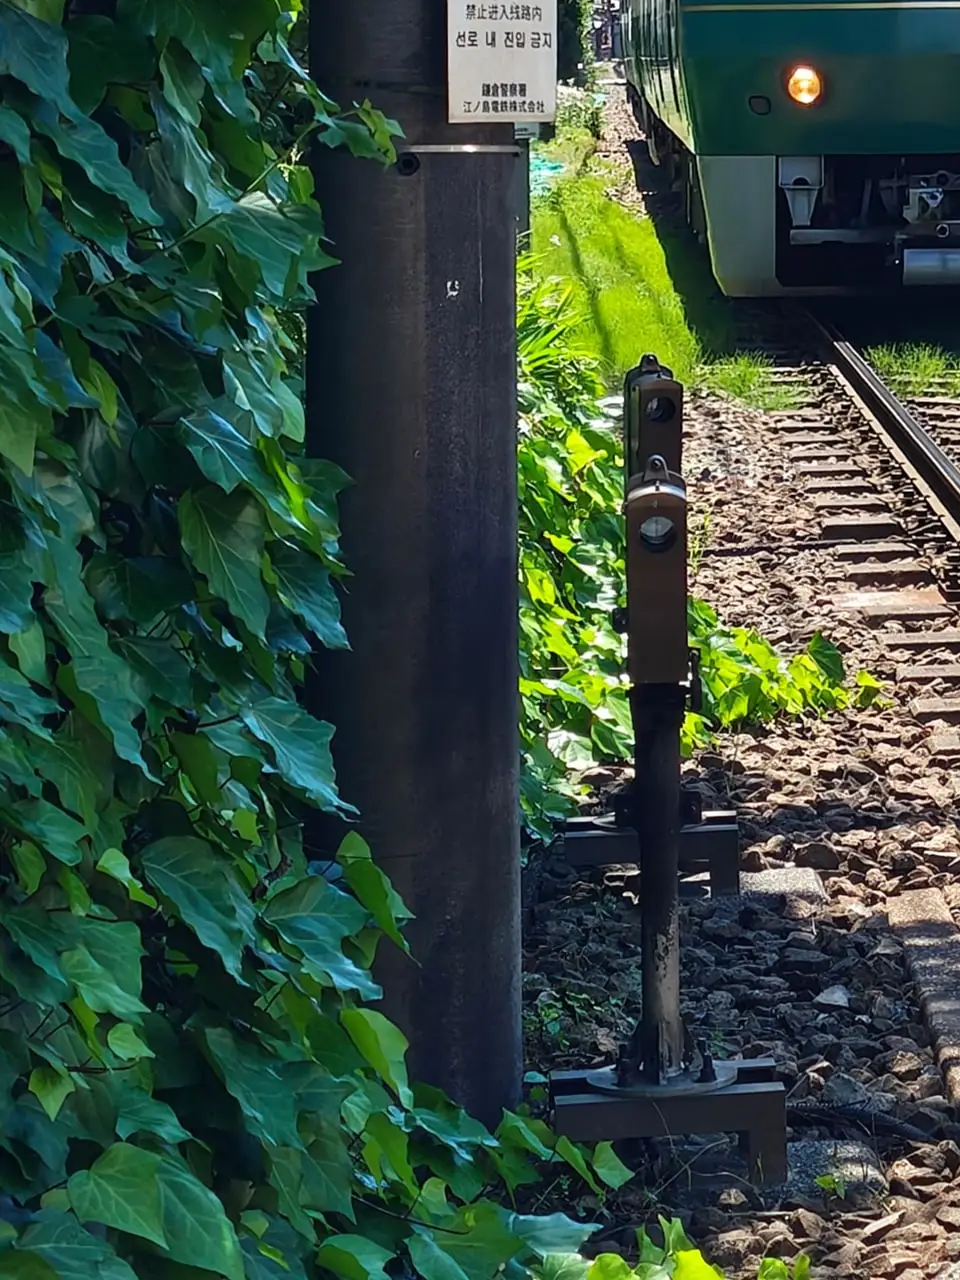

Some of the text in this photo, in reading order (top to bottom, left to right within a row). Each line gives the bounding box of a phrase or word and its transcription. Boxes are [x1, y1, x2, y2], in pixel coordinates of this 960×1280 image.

[465, 4, 542, 21] 禁止进入线路内
[456, 31, 552, 49] 선로 내 진입 금지
[463, 100, 545, 113] 江ノ島電鉄株式会社
